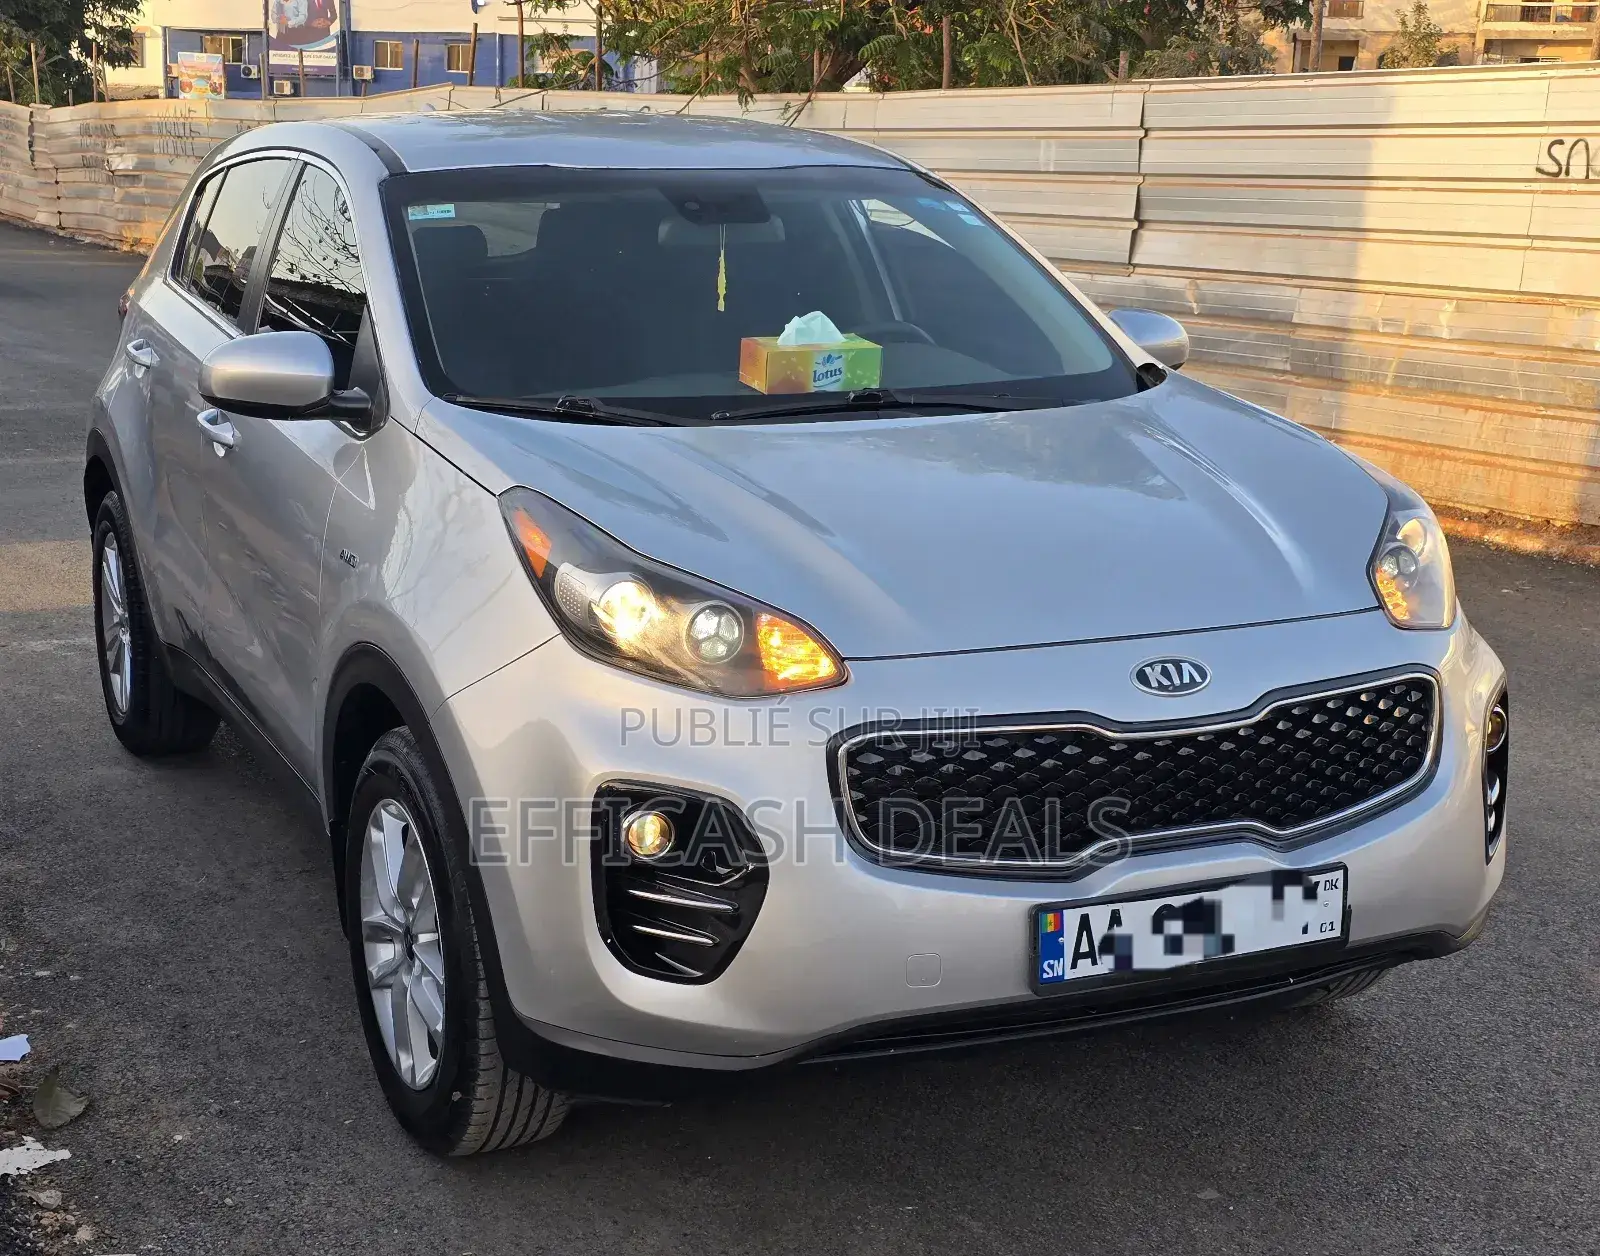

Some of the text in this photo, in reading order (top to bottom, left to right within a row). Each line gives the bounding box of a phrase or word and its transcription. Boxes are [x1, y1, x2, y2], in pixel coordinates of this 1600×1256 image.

[1142, 662, 1203, 688] KIA
[1323, 878, 1339, 891] DK
[1042, 957, 1063, 979] SN
